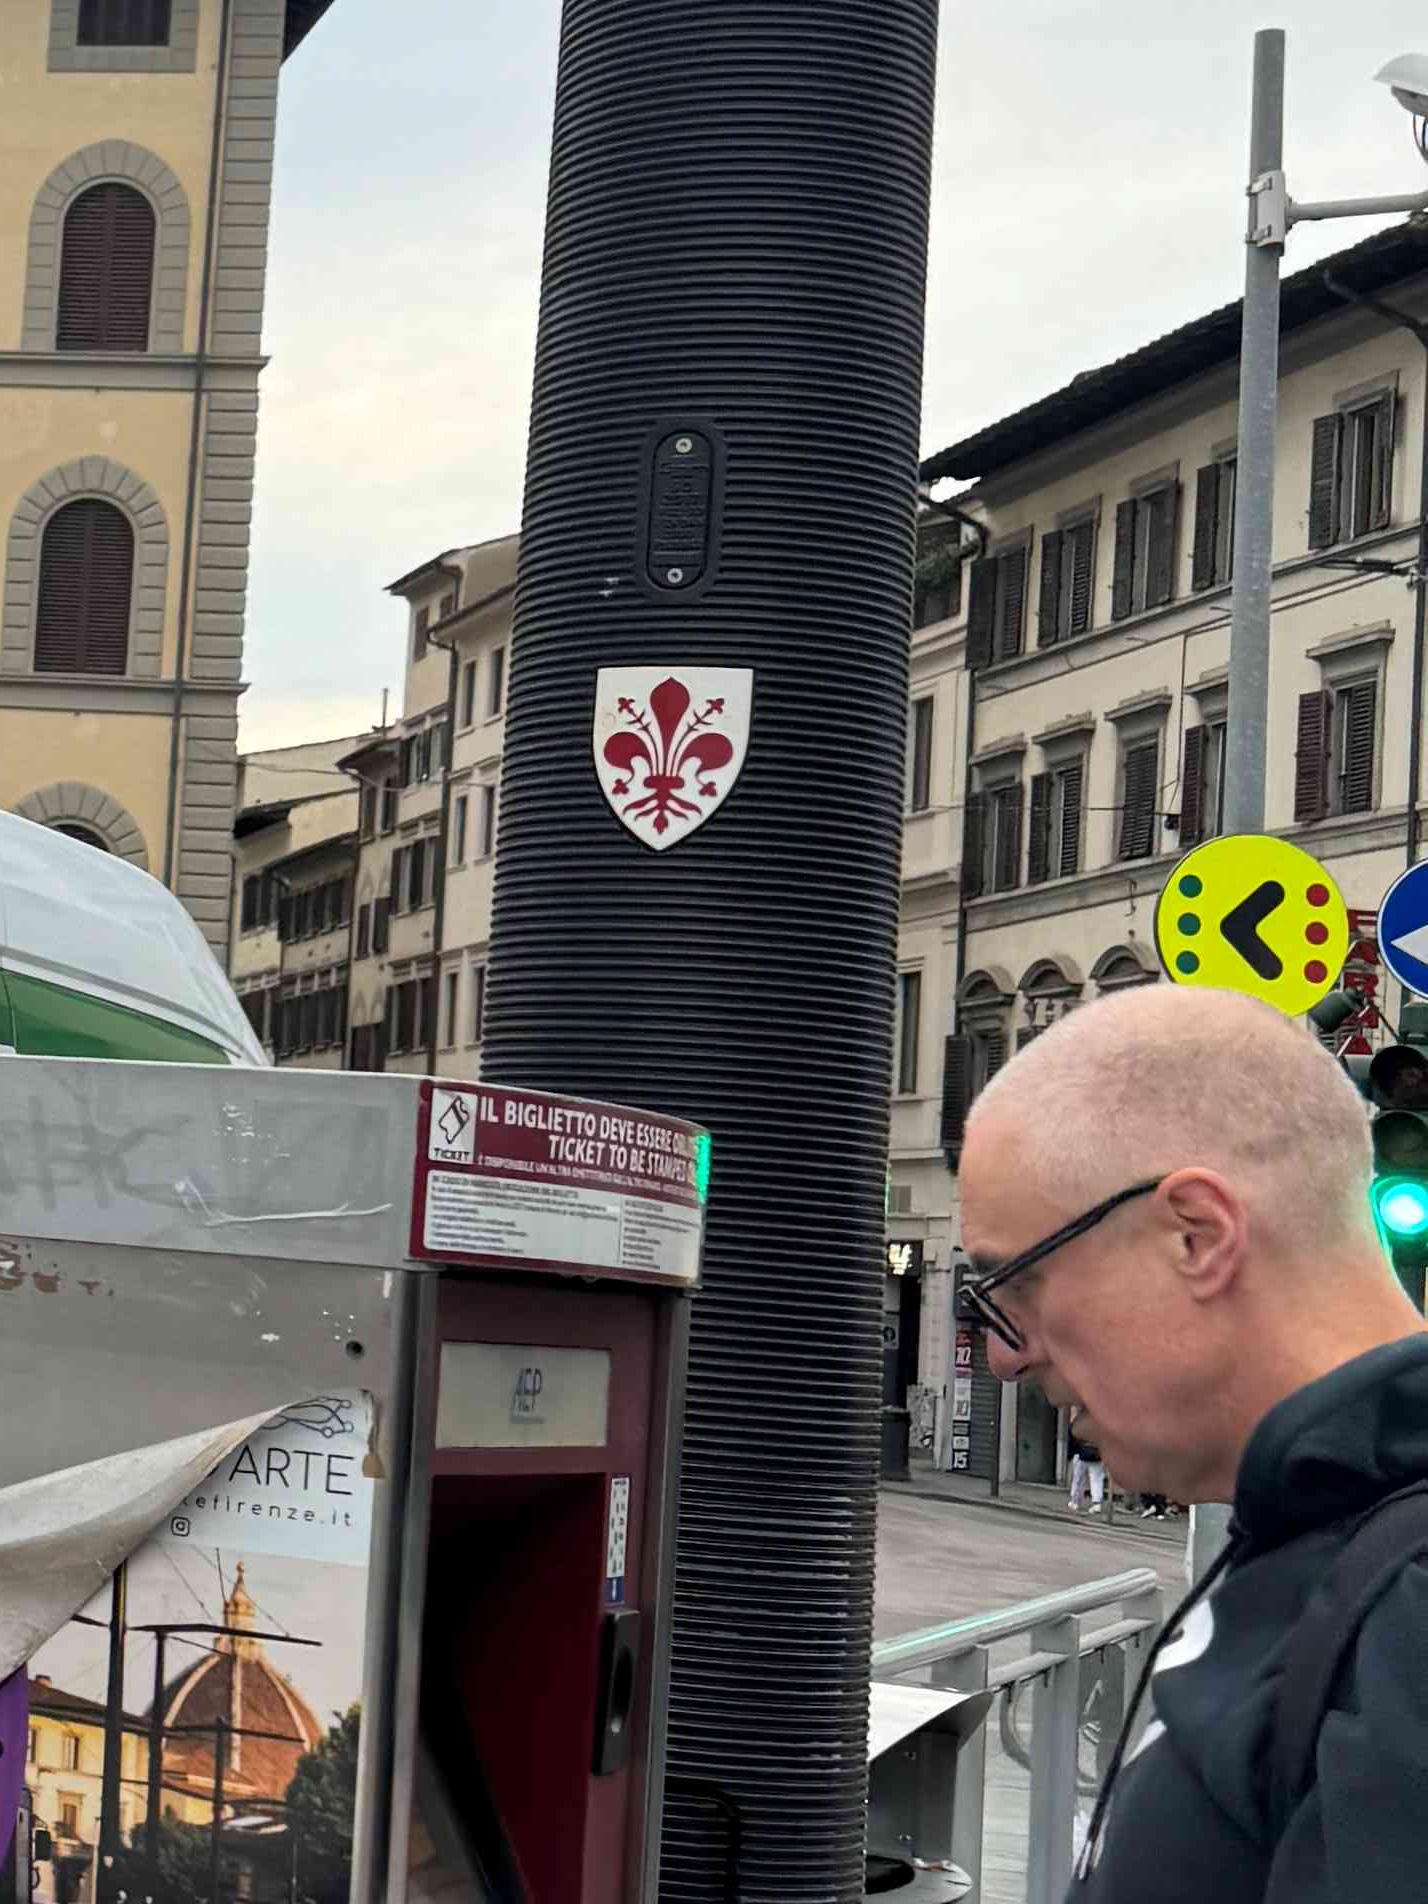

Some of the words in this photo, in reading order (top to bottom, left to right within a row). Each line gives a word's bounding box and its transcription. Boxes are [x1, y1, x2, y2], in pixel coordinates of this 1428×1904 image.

[480, 1096, 499, 1123] IL
[505, 1099, 596, 1137] BIGLIETTO
[599, 1115, 635, 1145] DEVE
[548, 1134, 606, 1166] TICKET
[609, 1144, 626, 1169] TO
[630, 1149, 646, 1174] BE
[228, 1444, 356, 1496] ARTE
